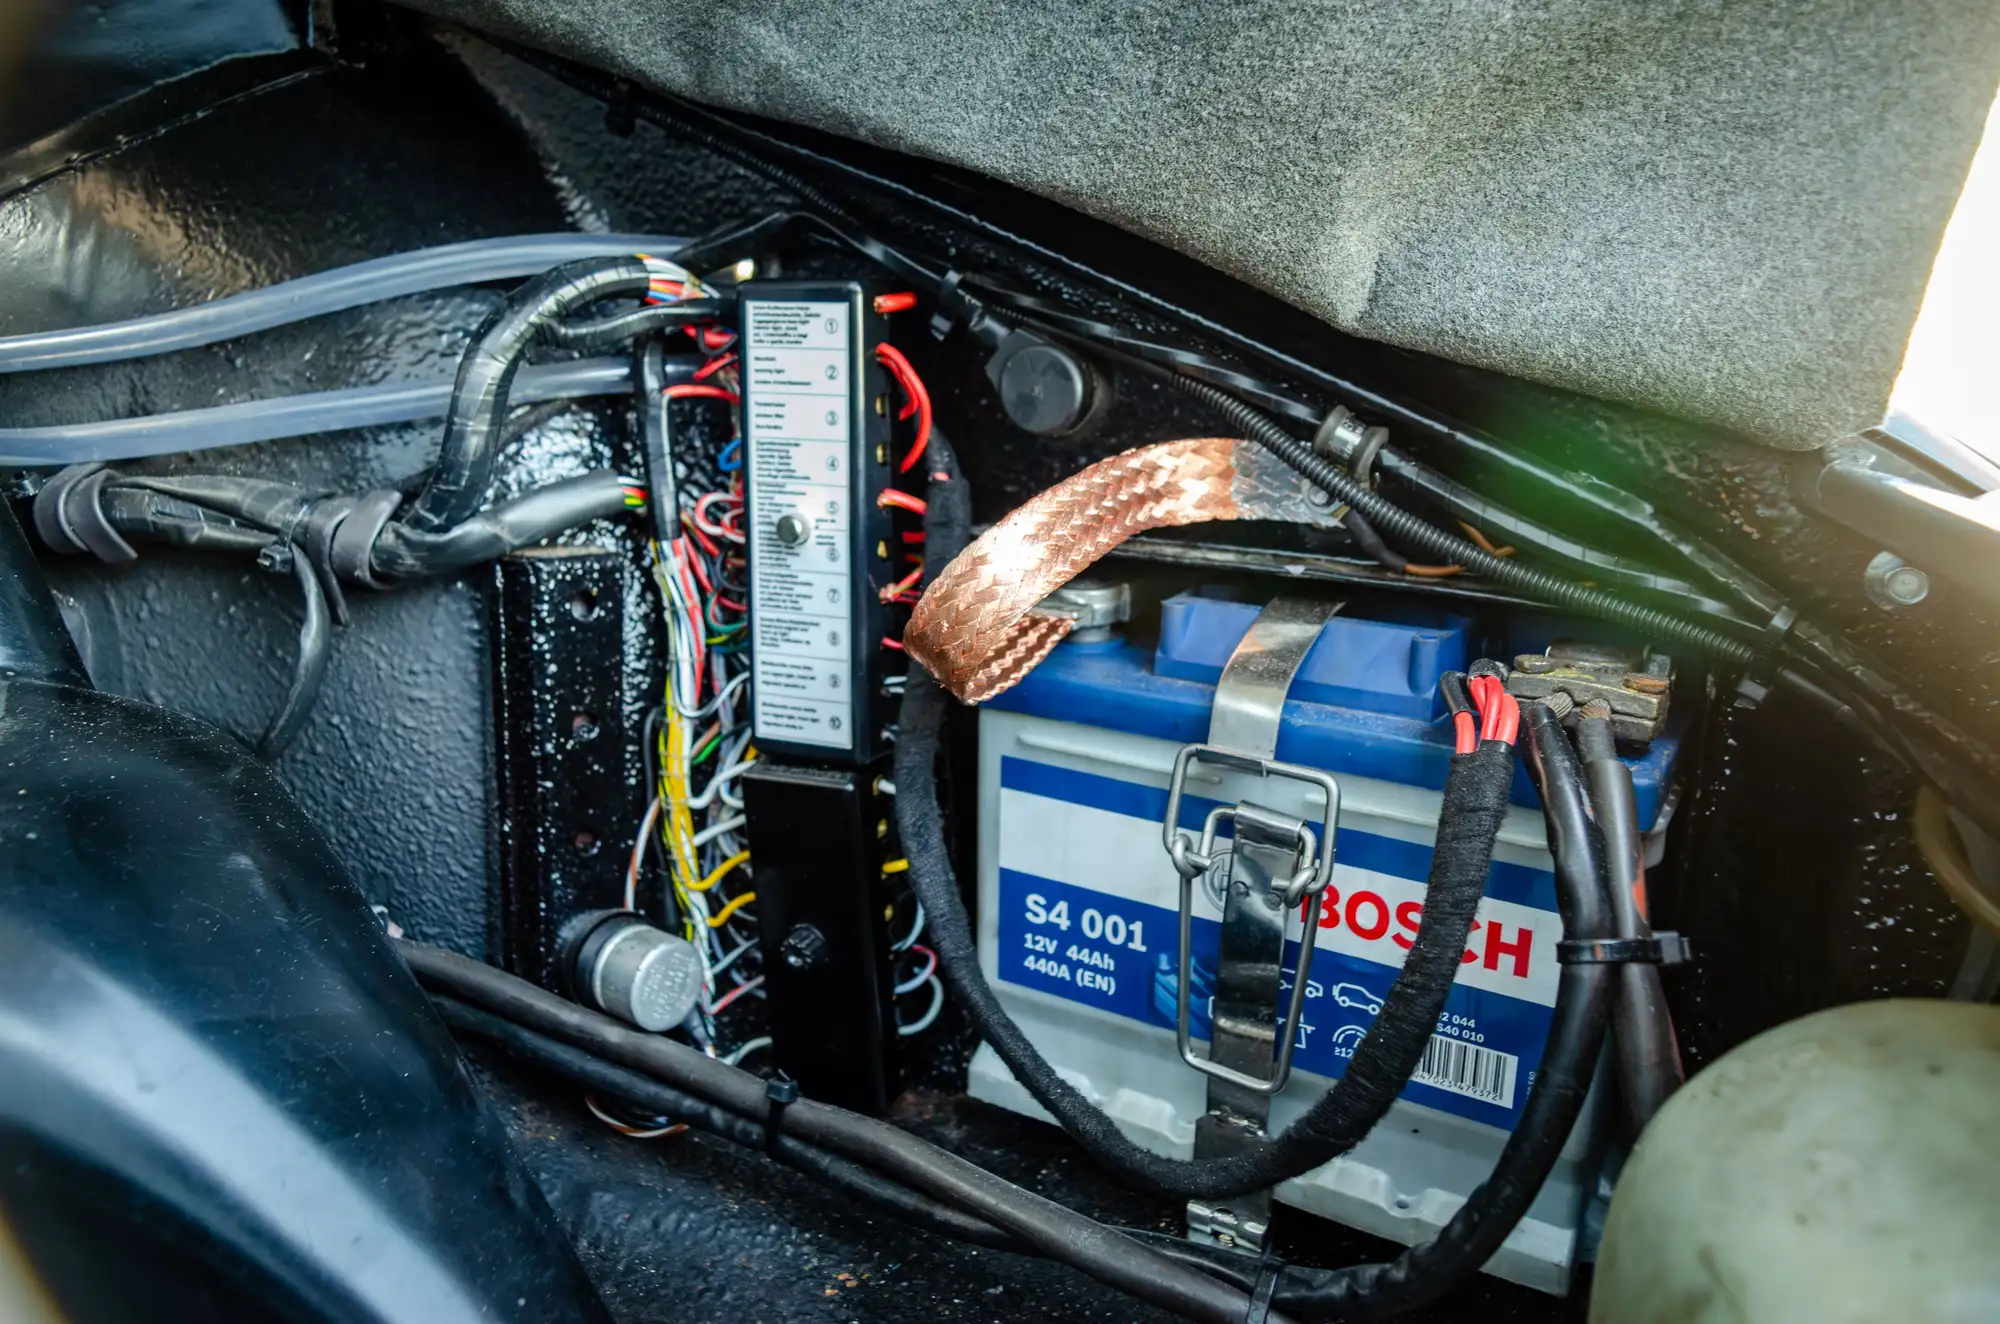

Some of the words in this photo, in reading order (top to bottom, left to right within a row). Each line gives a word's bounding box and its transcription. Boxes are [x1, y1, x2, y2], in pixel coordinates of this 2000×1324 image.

[1025, 893, 1071, 930] S4
[1081, 908, 1147, 952] 001
[1300, 885, 1533, 979] BOSH
[1024, 932, 1057, 954] 12V
[1066, 943, 1115, 971] 44Ah
[1023, 955, 1071, 981] 440A
[1076, 967, 1116, 995] (EN)
[1436, 1022, 1459, 1036] S40
[1462, 1029, 1484, 1043] 010
[1452, 1015, 1476, 1028] 044
